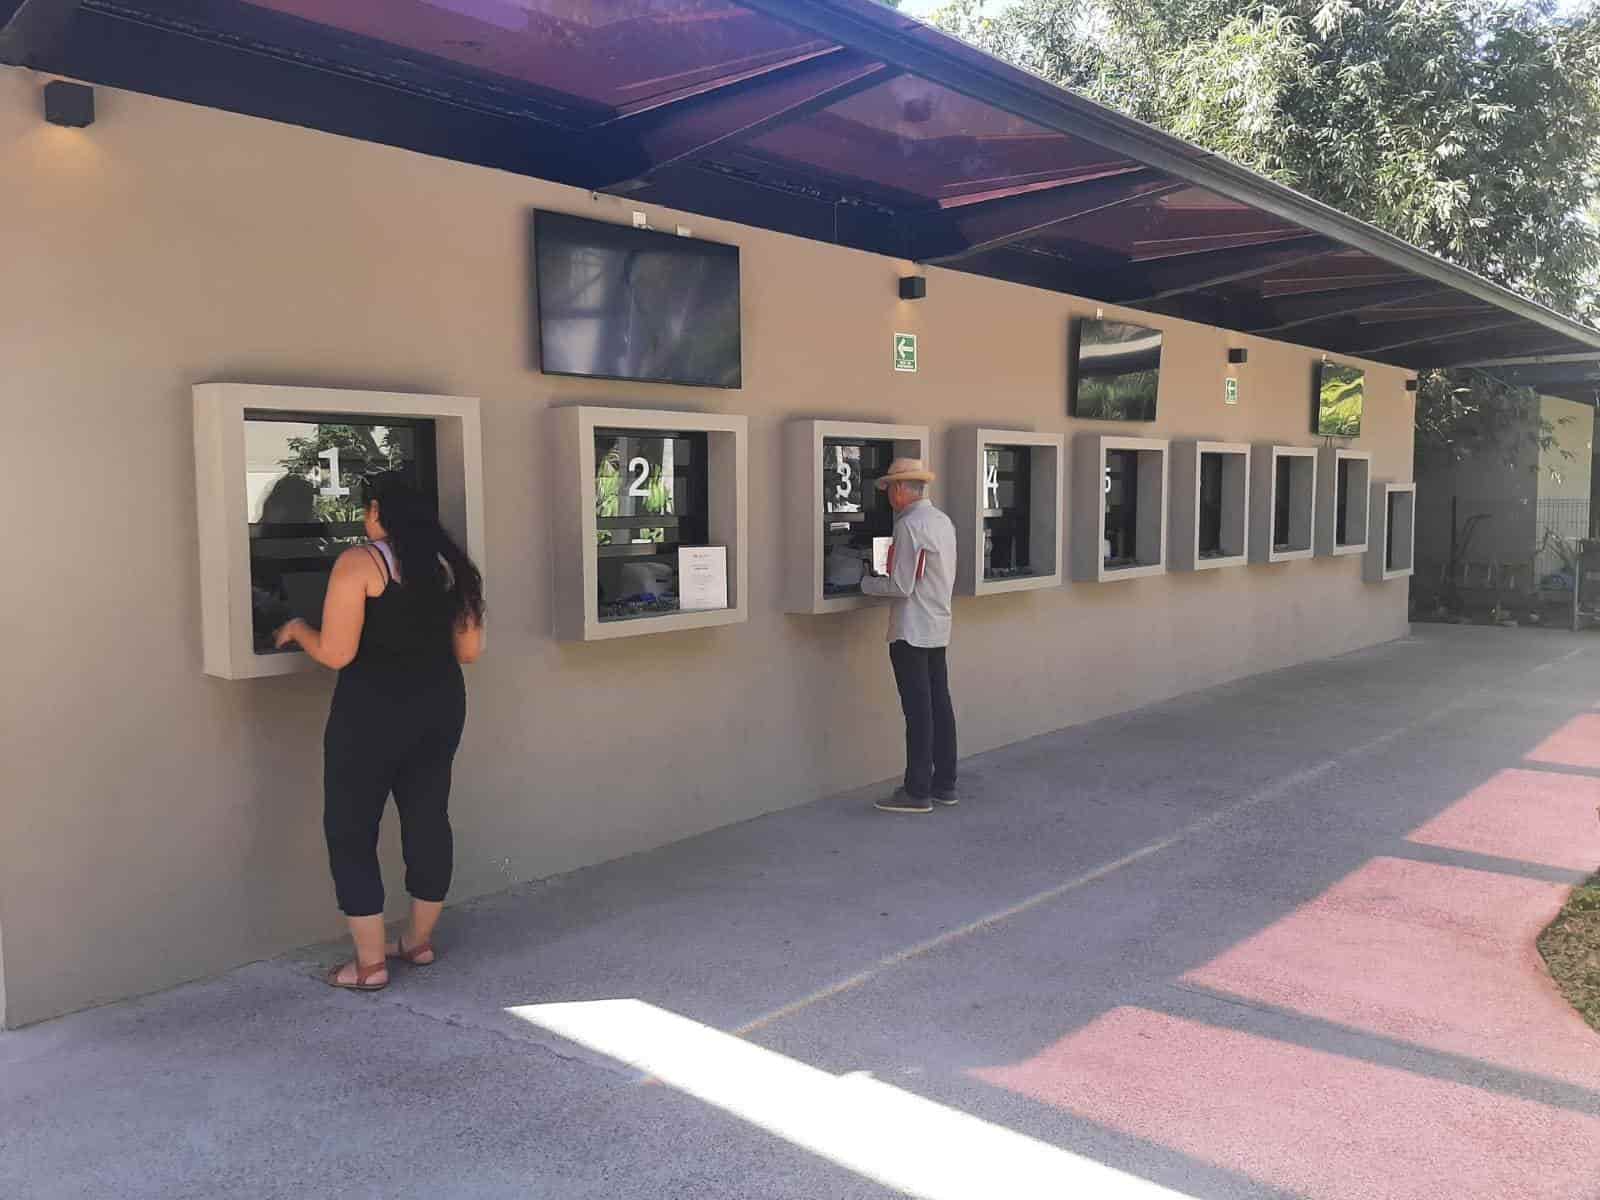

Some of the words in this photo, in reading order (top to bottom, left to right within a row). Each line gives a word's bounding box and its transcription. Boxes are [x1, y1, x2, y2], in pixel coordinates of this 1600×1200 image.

[318, 447, 350, 496] 1
[629, 456, 650, 497] 2
[836, 462, 852, 498] 3
[984, 464, 999, 498] 4
